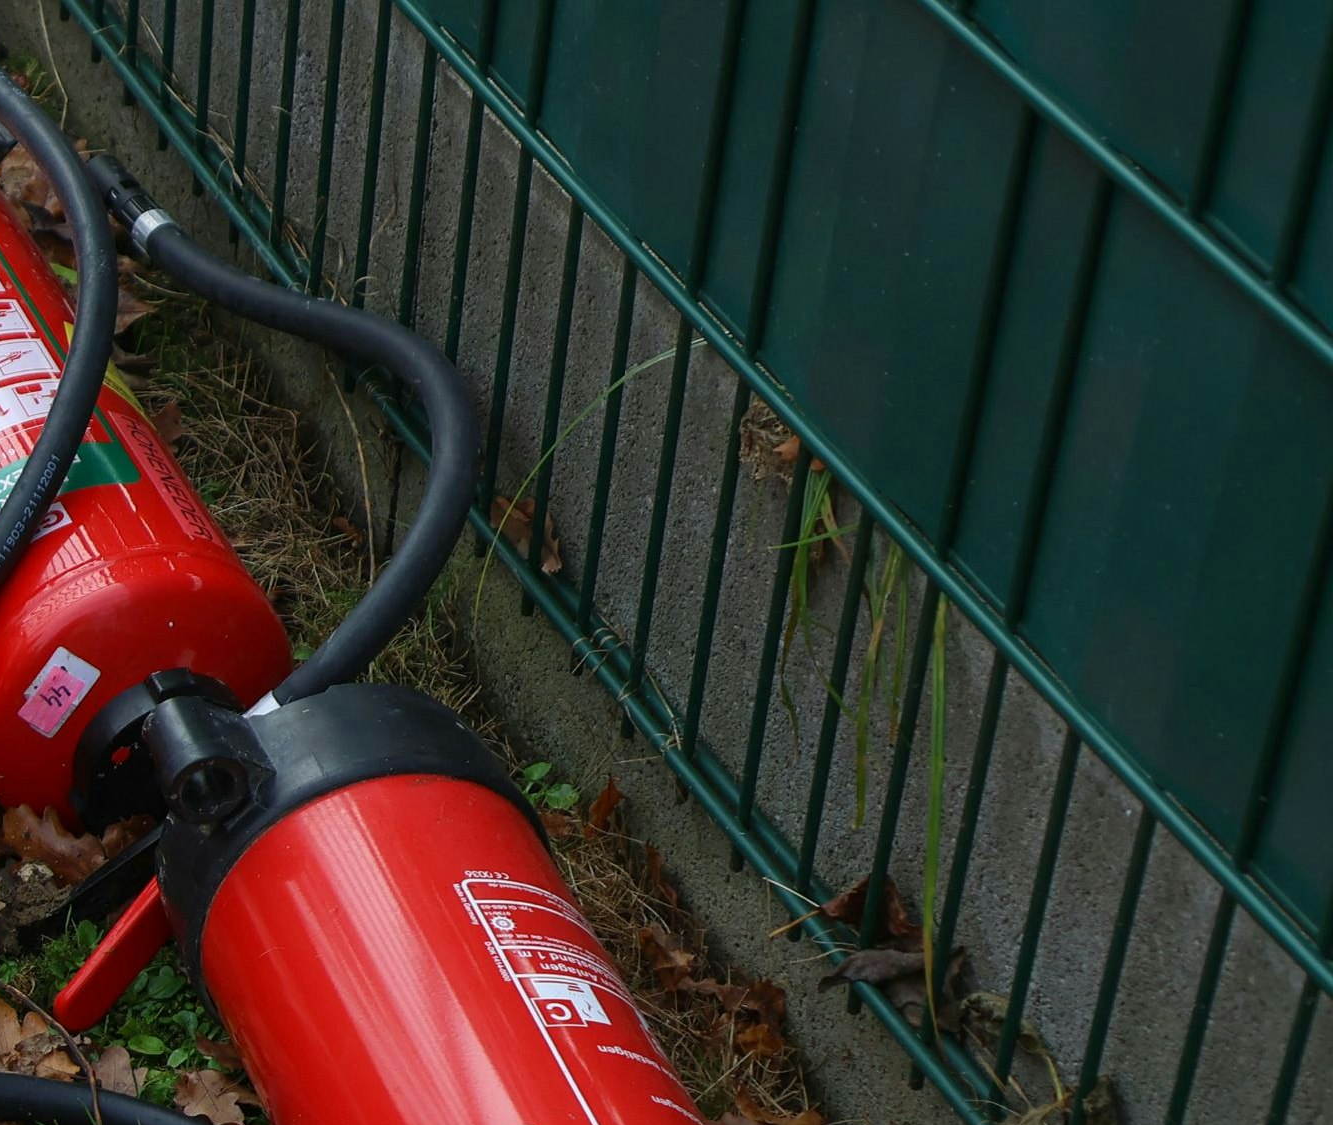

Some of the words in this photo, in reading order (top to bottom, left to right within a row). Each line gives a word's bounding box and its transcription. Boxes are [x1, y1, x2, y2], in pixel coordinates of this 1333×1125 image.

[462, 901, 479, 925] Germany
[539, 962, 597, 982] Anlagen
[545, 1001, 572, 1022] C
